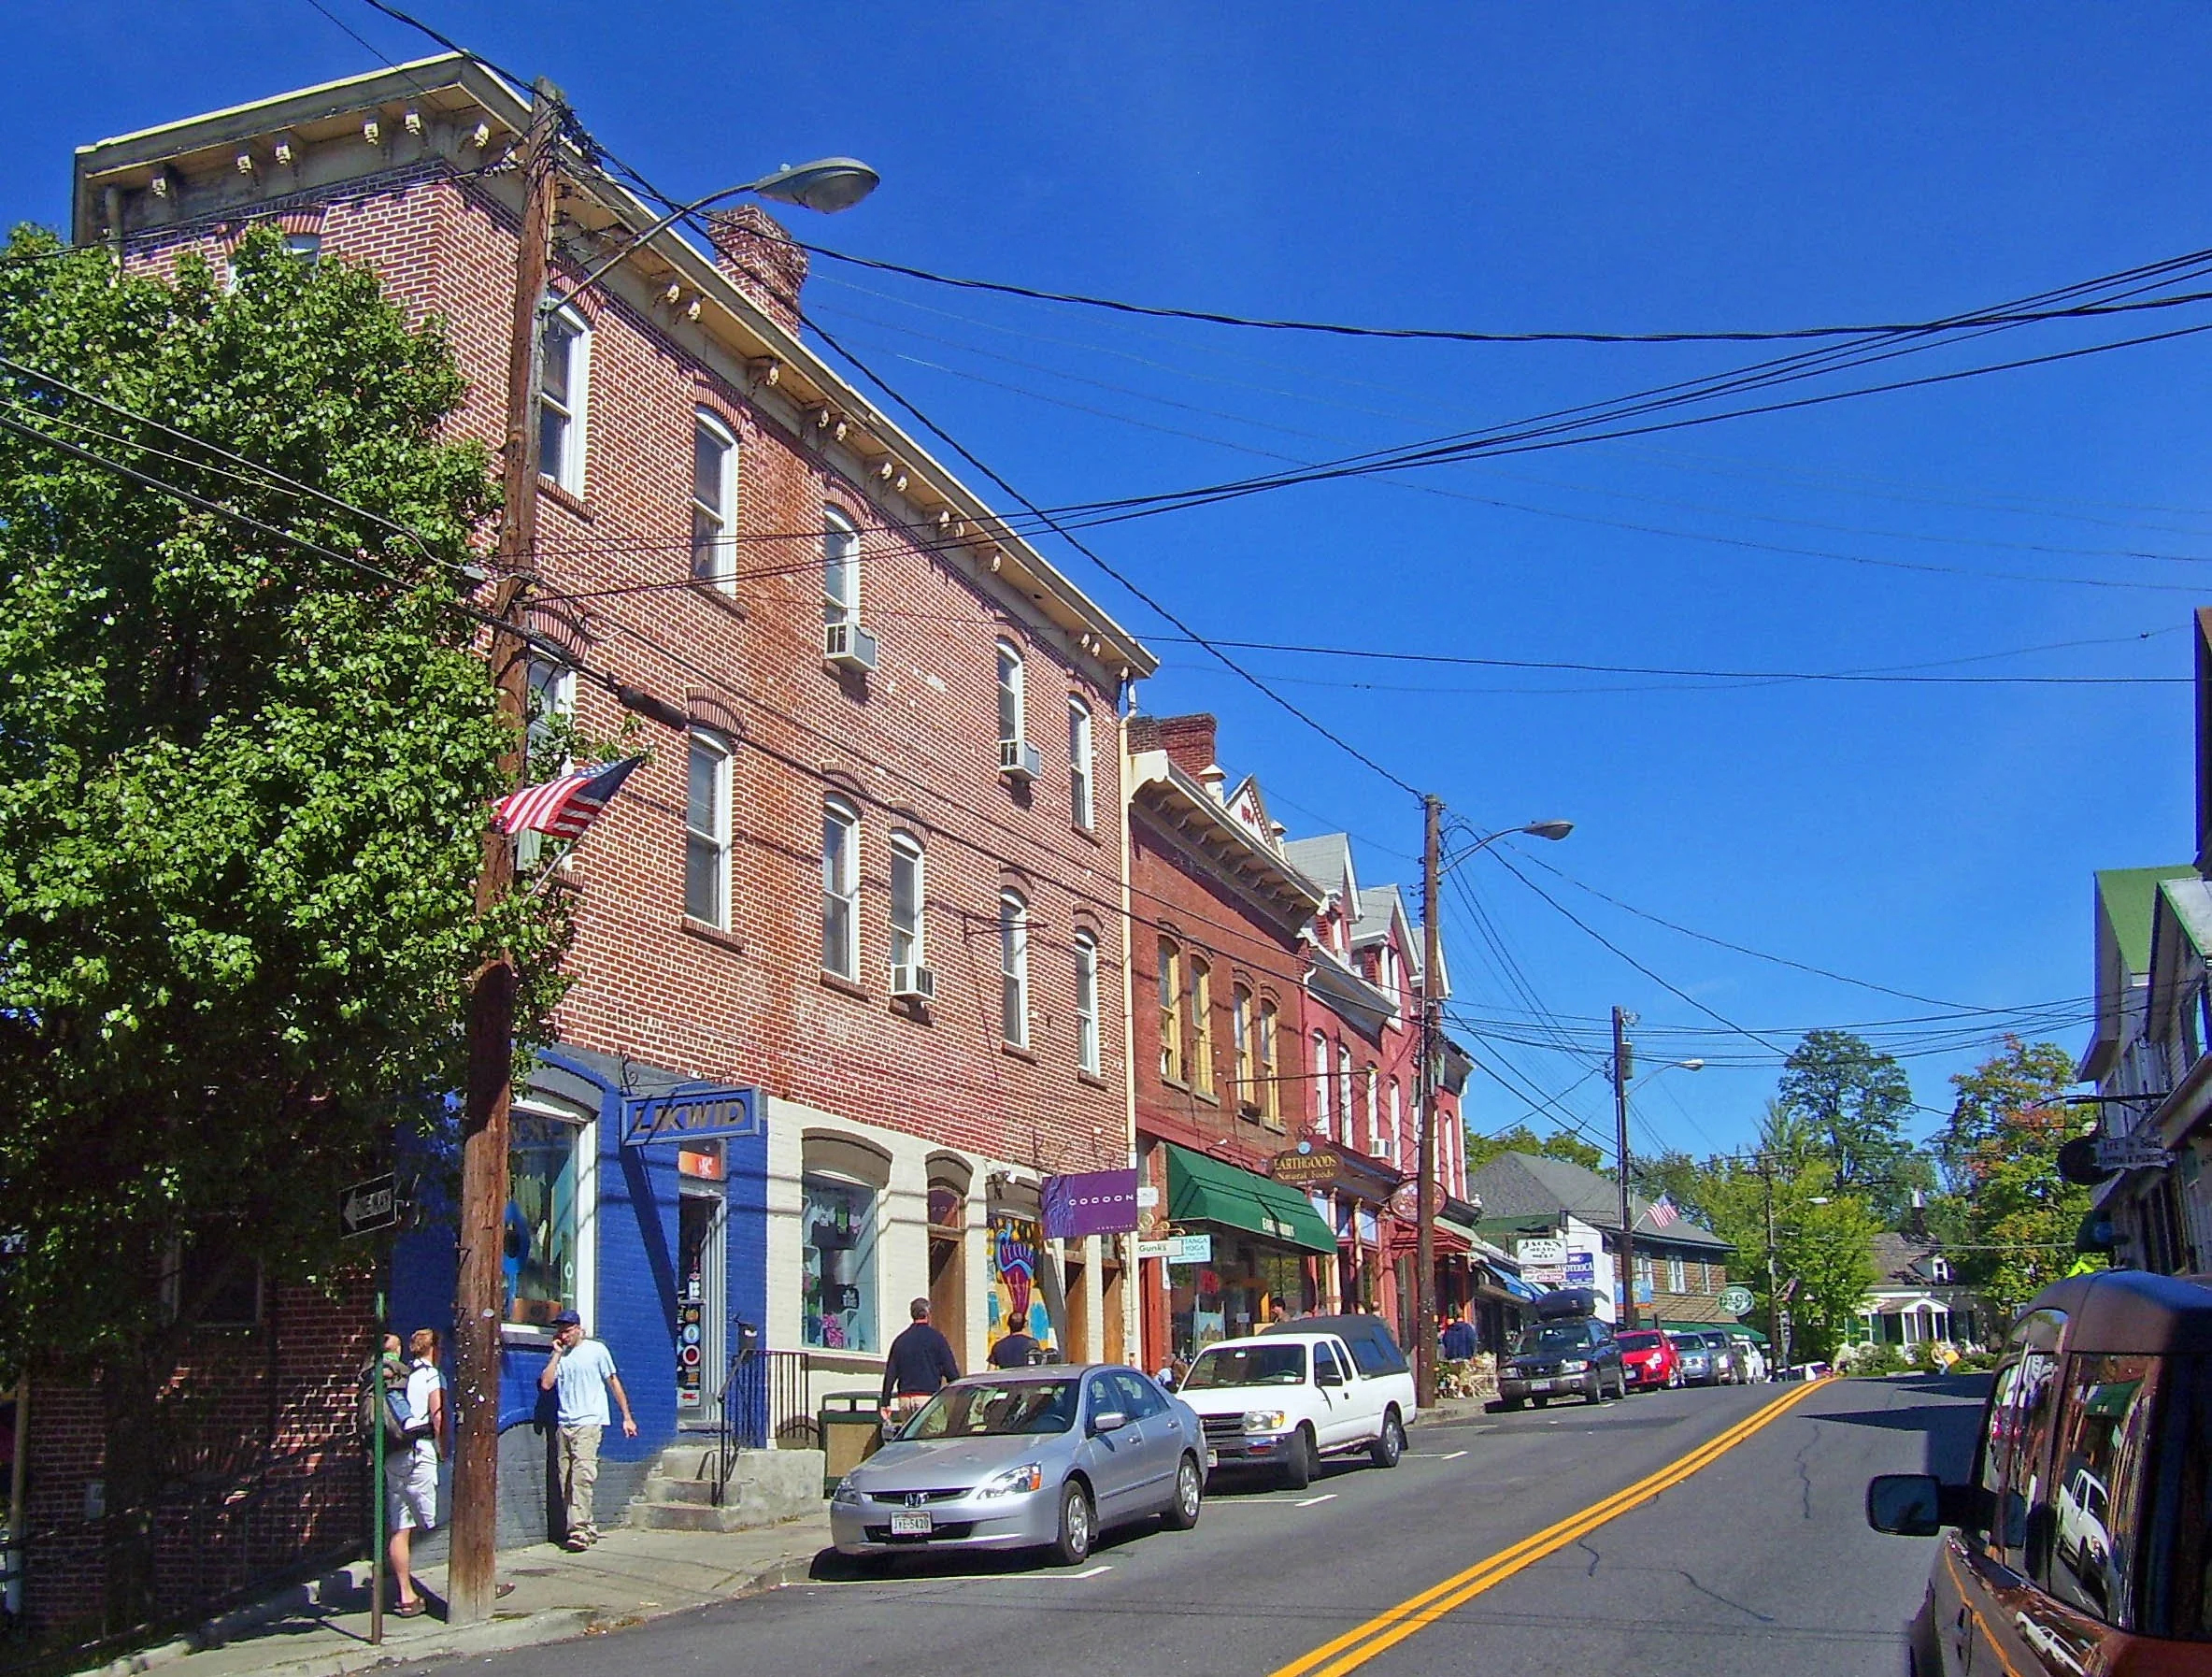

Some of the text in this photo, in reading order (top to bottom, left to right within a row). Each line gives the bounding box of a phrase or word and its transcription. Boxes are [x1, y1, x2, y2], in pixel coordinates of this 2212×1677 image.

[634, 1097, 746, 1133] LIKWID
[1274, 1155, 1338, 1170] EARTHGOODS
[1277, 1168, 1334, 1181] Natural Foods
[1068, 1194, 1134, 1206] COCOON
[1138, 1244, 1167, 1253] Gunks
